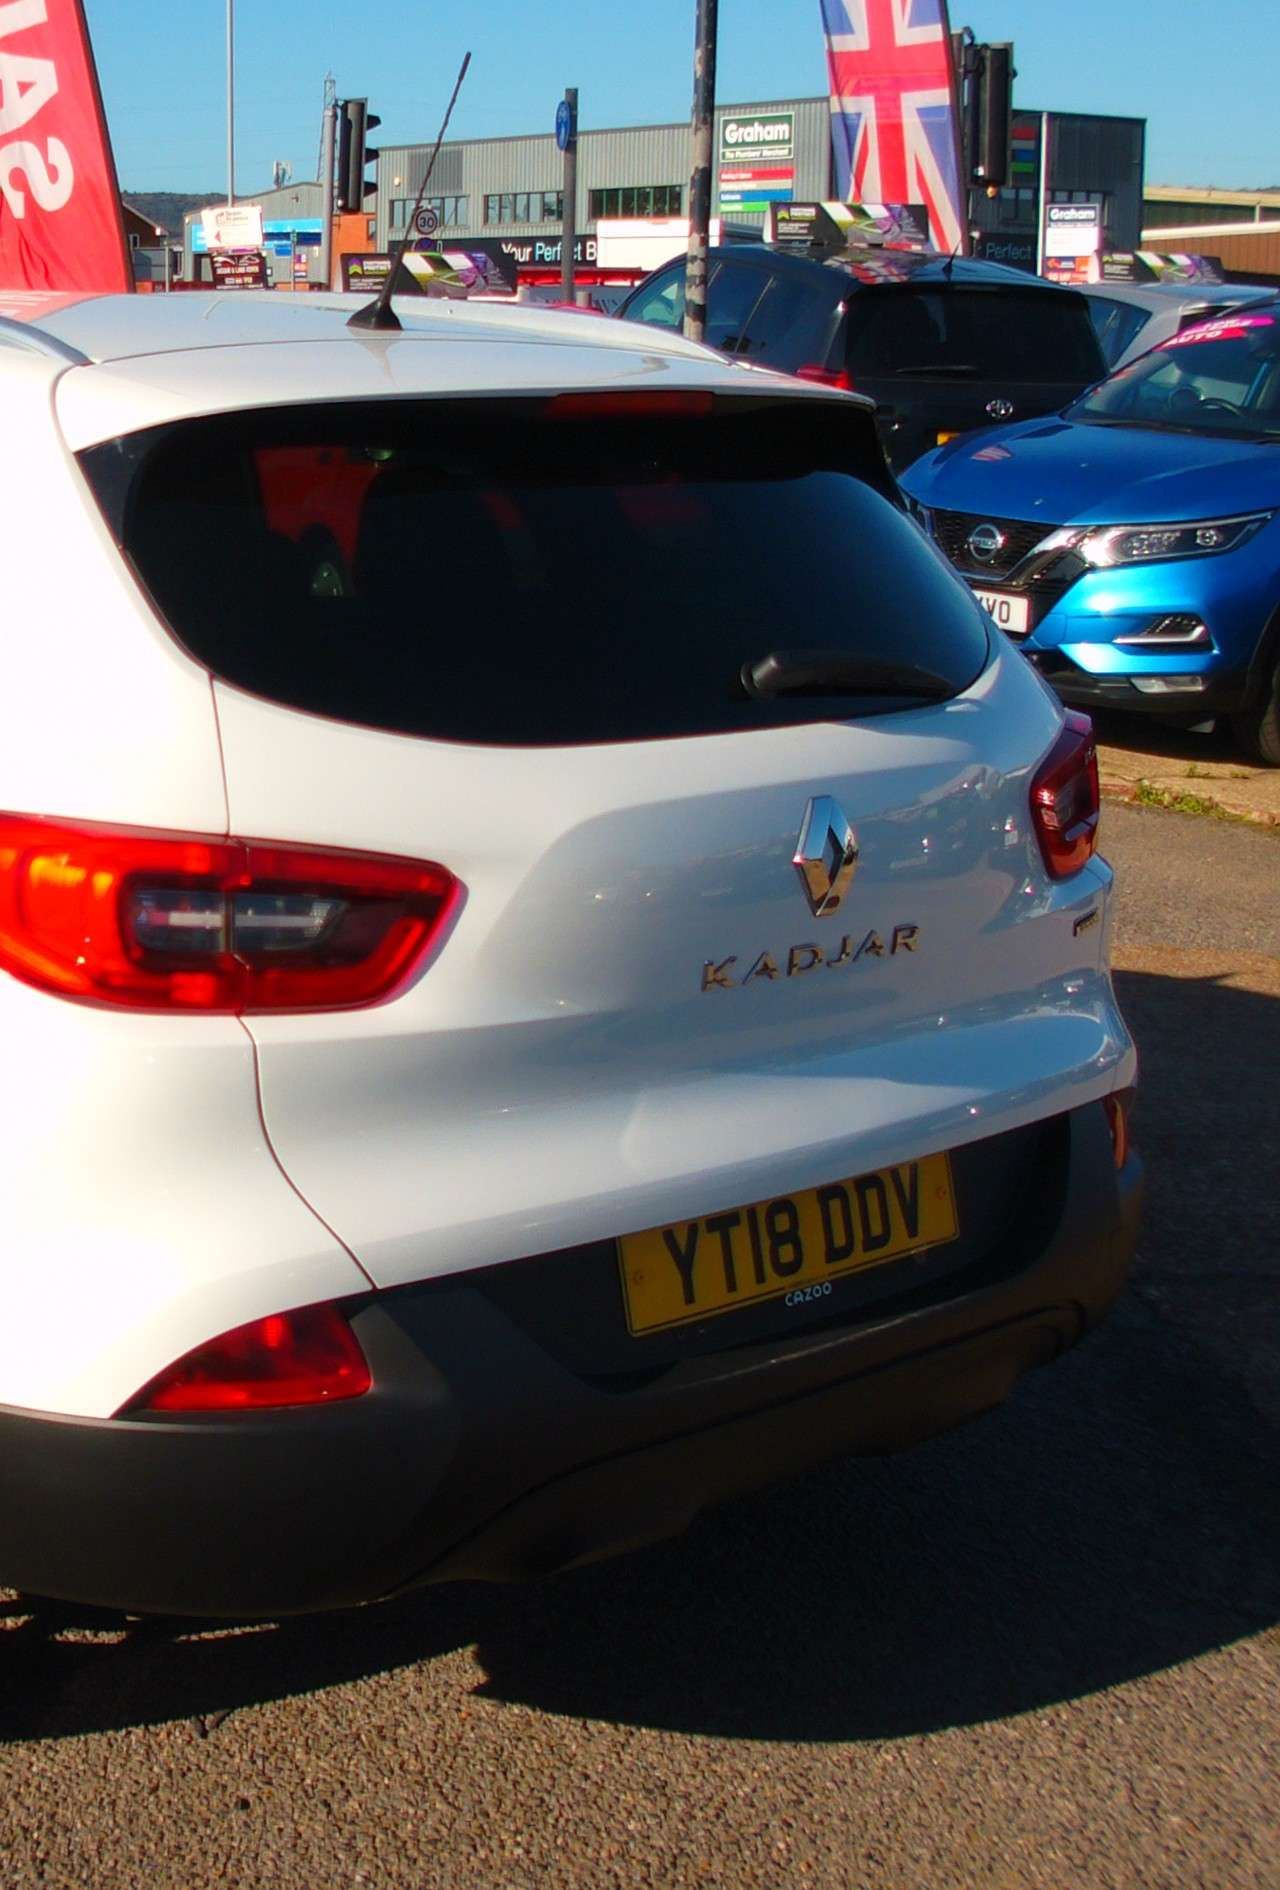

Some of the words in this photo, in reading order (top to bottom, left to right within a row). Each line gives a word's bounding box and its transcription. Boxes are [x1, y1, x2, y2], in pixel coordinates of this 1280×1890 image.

[724, 121, 791, 144] Graham
[419, 216, 435, 230] 30
[1050, 207, 1096, 221] Graham
[535, 241, 583, 262] Perft
[978, 595, 1011, 624] VO
[700, 923, 920, 993] KADJAR
[661, 1198, 804, 1306] YT18
[815, 1162, 919, 1265] DDV
[784, 1281, 833, 1308] CAZOO
